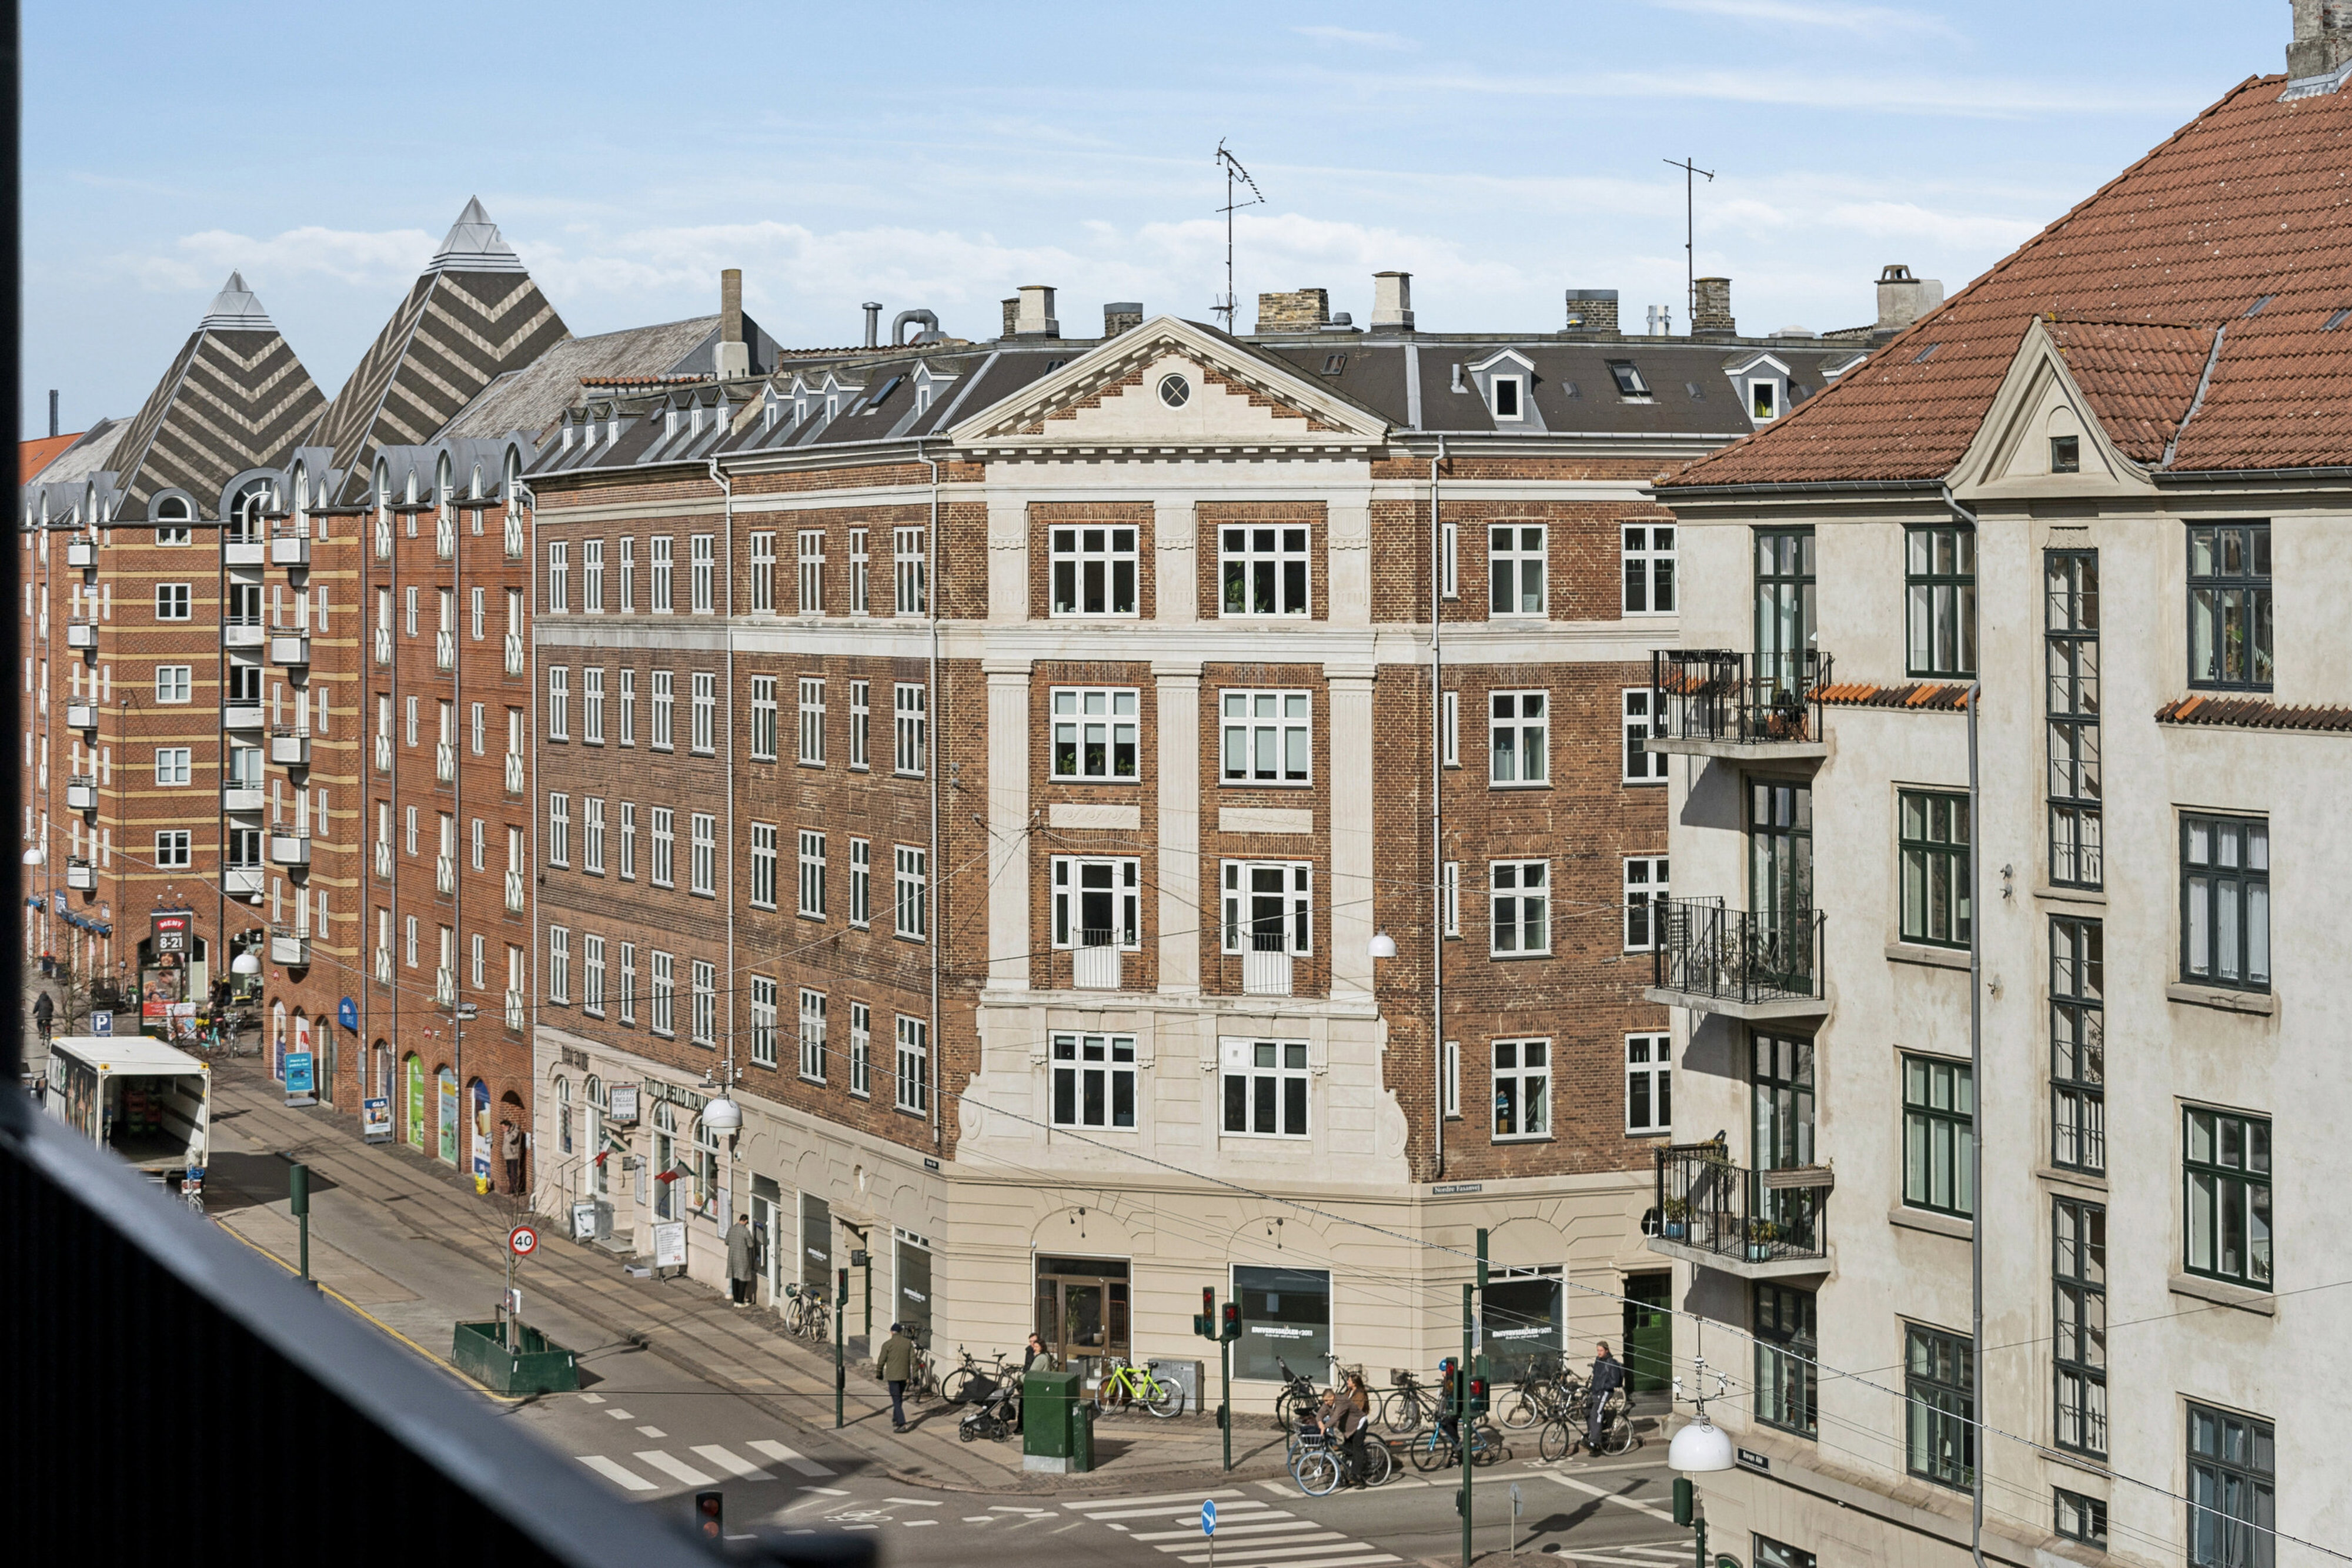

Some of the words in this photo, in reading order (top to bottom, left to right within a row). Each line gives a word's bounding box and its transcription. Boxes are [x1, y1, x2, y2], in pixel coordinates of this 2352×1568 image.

[160, 937, 182, 948] 8-21
[96, 1015, 108, 1030] P
[515, 1235, 532, 1246] 40
